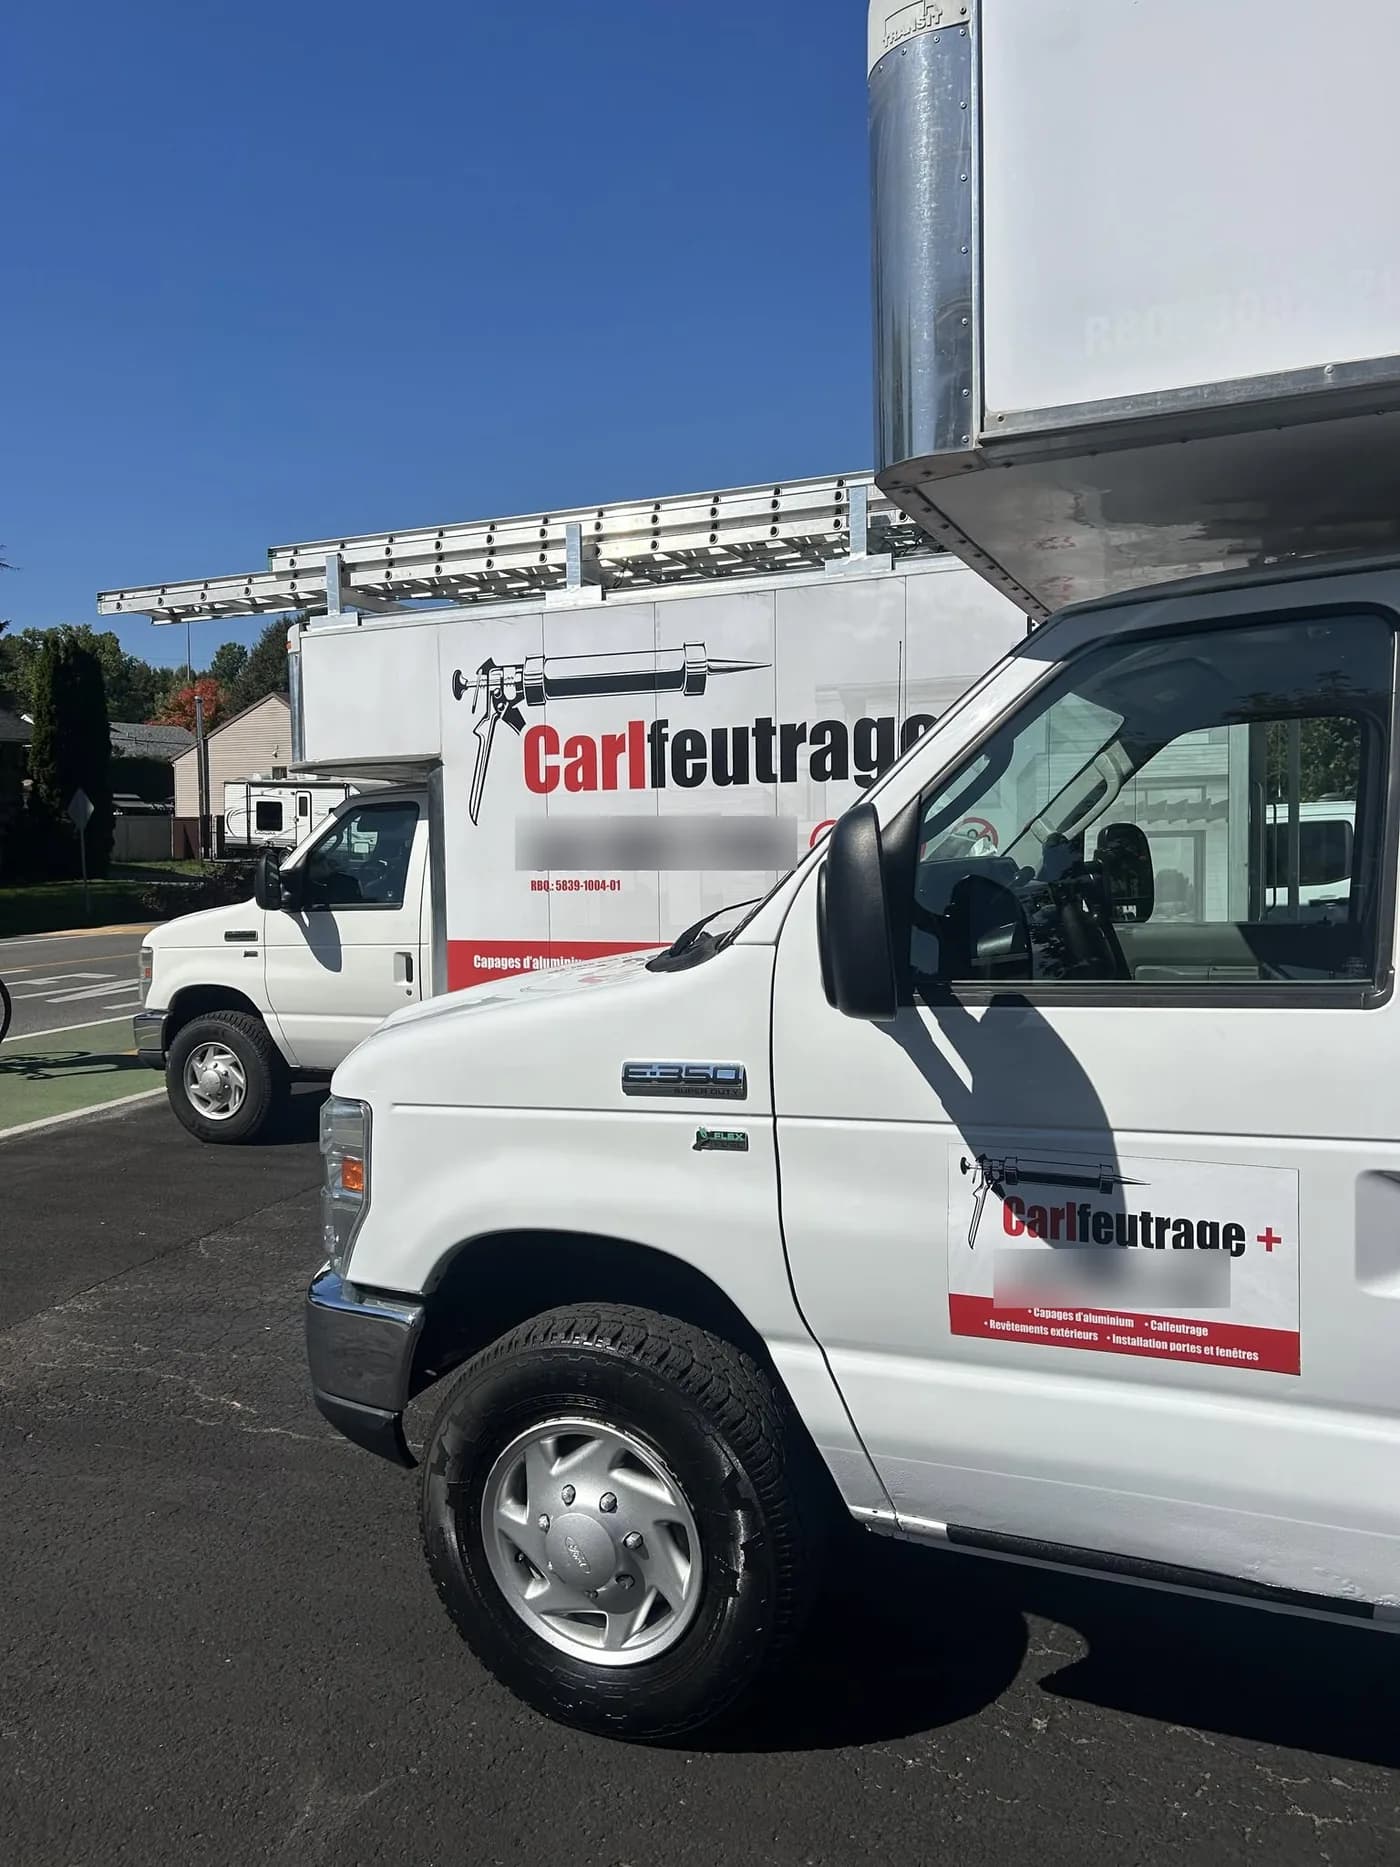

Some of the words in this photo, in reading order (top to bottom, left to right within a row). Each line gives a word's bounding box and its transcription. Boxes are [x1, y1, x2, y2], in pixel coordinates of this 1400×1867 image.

[555, 879, 621, 891] 5839-1004-01
[473, 954, 521, 970] Capages
[709, 1088, 739, 1096] DUTY
[713, 1132, 745, 1141] FLEX
[1033, 1307, 1075, 1322] Capages
[1075, 1311, 1135, 1328] d'aluminium
[1150, 1319, 1209, 1337] Calfeutrage
[989, 1318, 1049, 1336] Revêtements
[1050, 1326, 1099, 1341] extérieurs
[1112, 1333, 1168, 1350] Installation
[1169, 1341, 1202, 1355] portes
[1203, 1345, 1214, 1356] et
[1215, 1346, 1259, 1361] fenêtres
